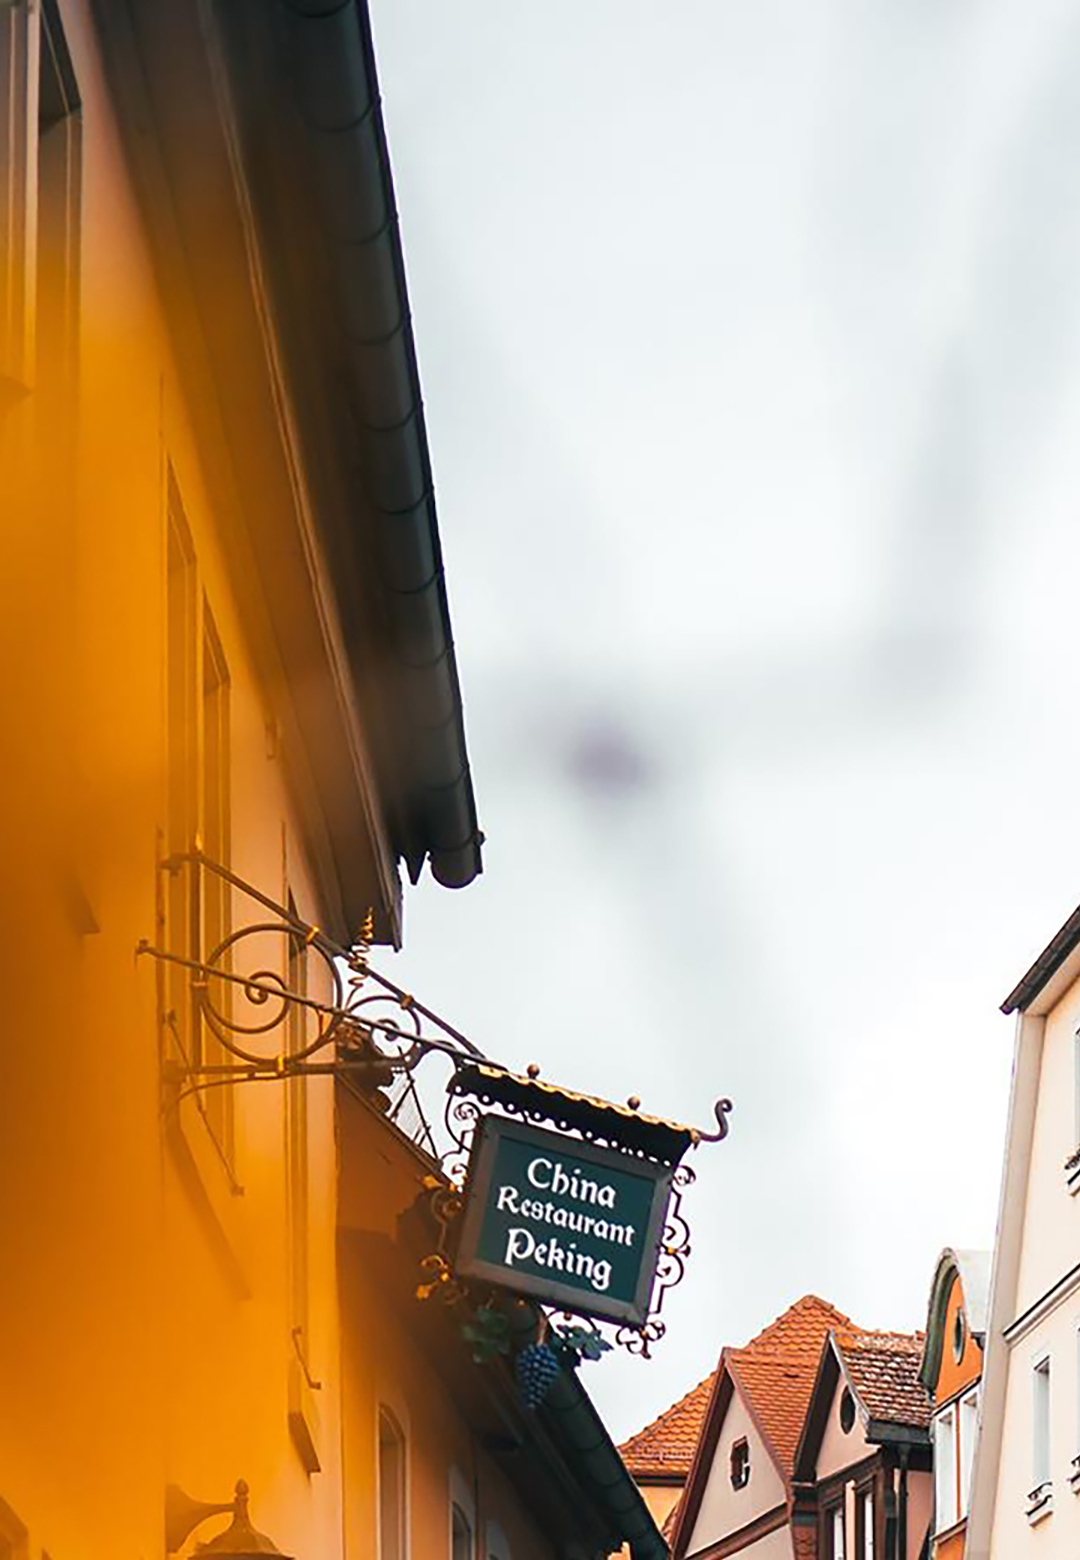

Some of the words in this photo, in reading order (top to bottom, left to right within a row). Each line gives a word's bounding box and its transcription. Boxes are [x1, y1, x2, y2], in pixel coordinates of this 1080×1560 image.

[527, 1158, 616, 1208] China
[497, 1186, 636, 1246] Restaurant
[504, 1228, 612, 1290] Peking
